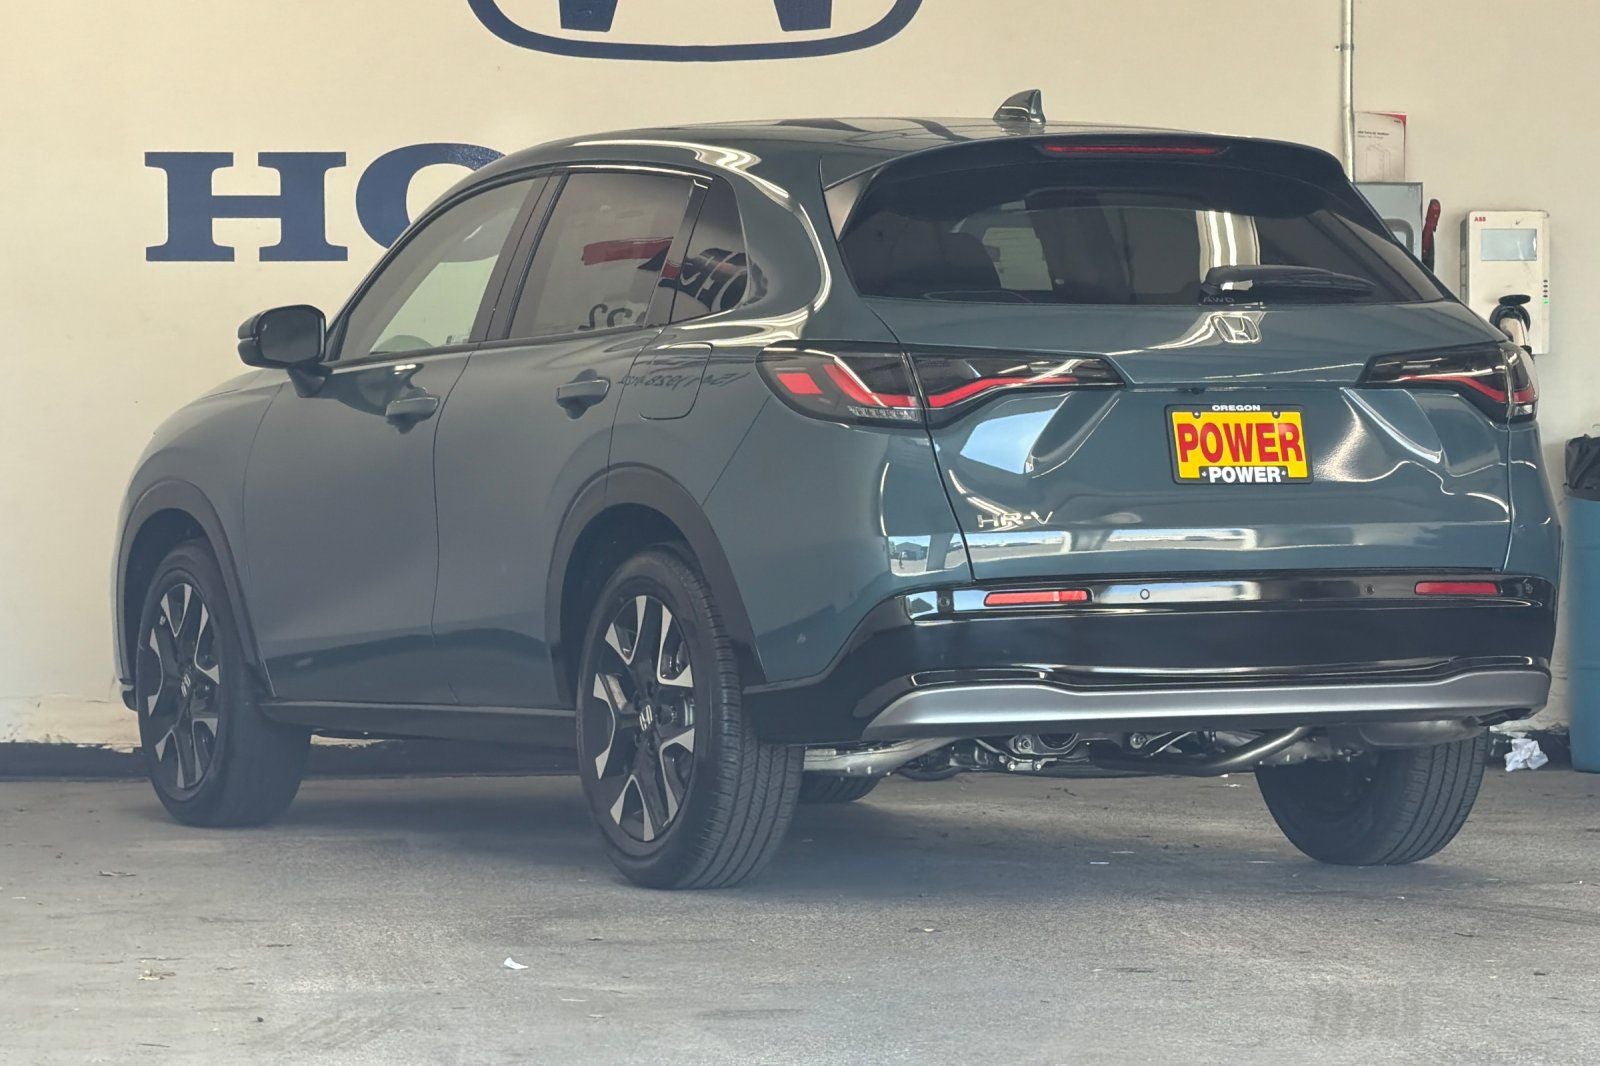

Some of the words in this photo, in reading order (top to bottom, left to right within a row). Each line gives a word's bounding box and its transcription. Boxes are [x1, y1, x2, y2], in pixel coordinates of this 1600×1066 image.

[1176, 422, 1303, 463] POWER
[1208, 466, 1282, 483] POWER
[976, 511, 1054, 528] HR-V
